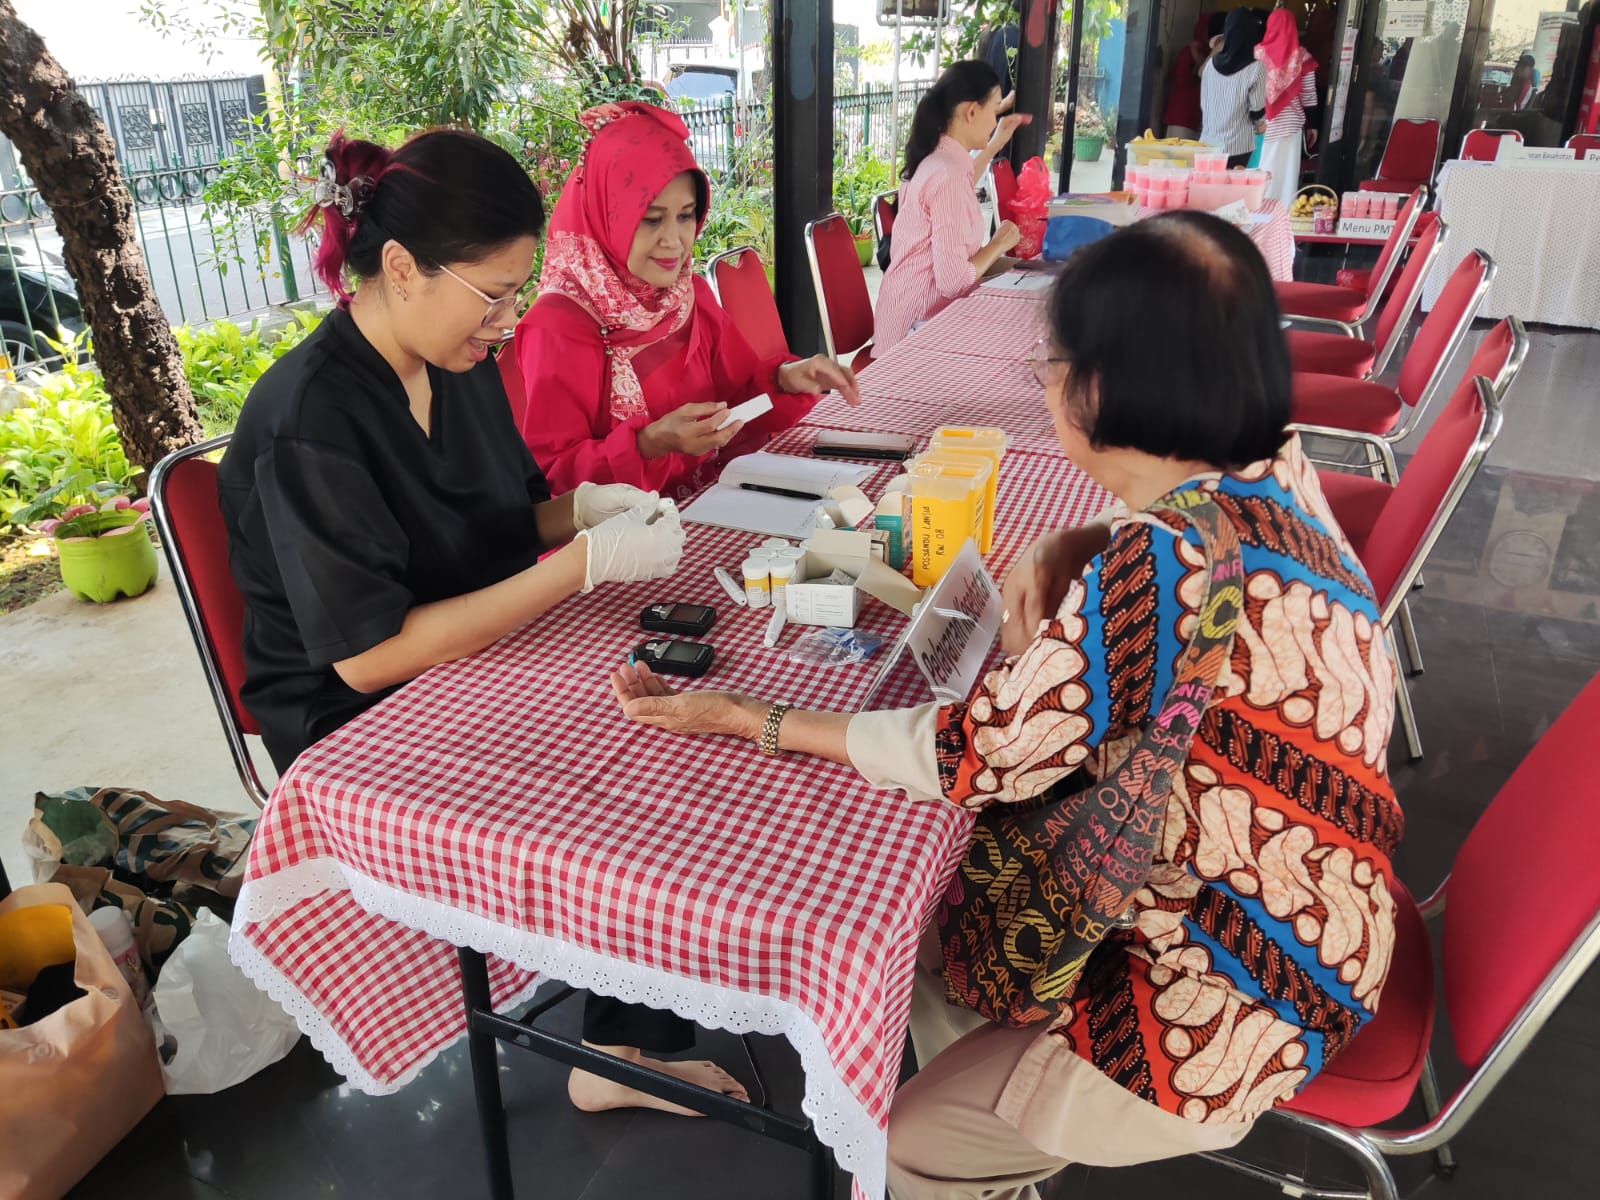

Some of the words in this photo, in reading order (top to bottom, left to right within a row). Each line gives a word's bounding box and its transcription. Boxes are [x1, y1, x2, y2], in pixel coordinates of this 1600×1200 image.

[1343, 222, 1370, 233] Menu
[922, 506, 930, 530] LANSIA
[936, 529, 945, 541] 08
[920, 615, 969, 687] Pelayanan
[951, 568, 992, 628] Kesehatan
[1035, 811, 1071, 850] SAN
